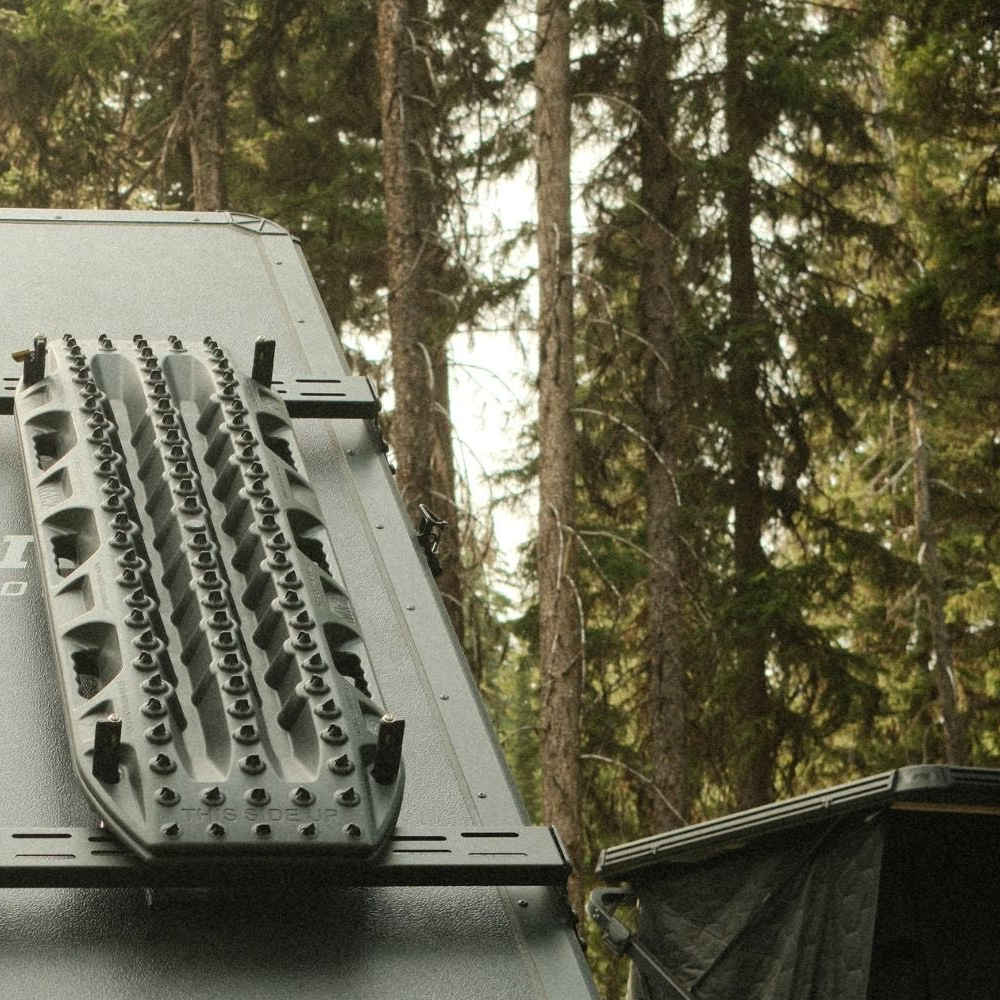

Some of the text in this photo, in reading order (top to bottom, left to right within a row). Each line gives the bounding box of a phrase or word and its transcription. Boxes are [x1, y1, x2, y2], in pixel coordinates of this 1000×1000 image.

[181, 808, 338, 822] THIS SIDE UP
